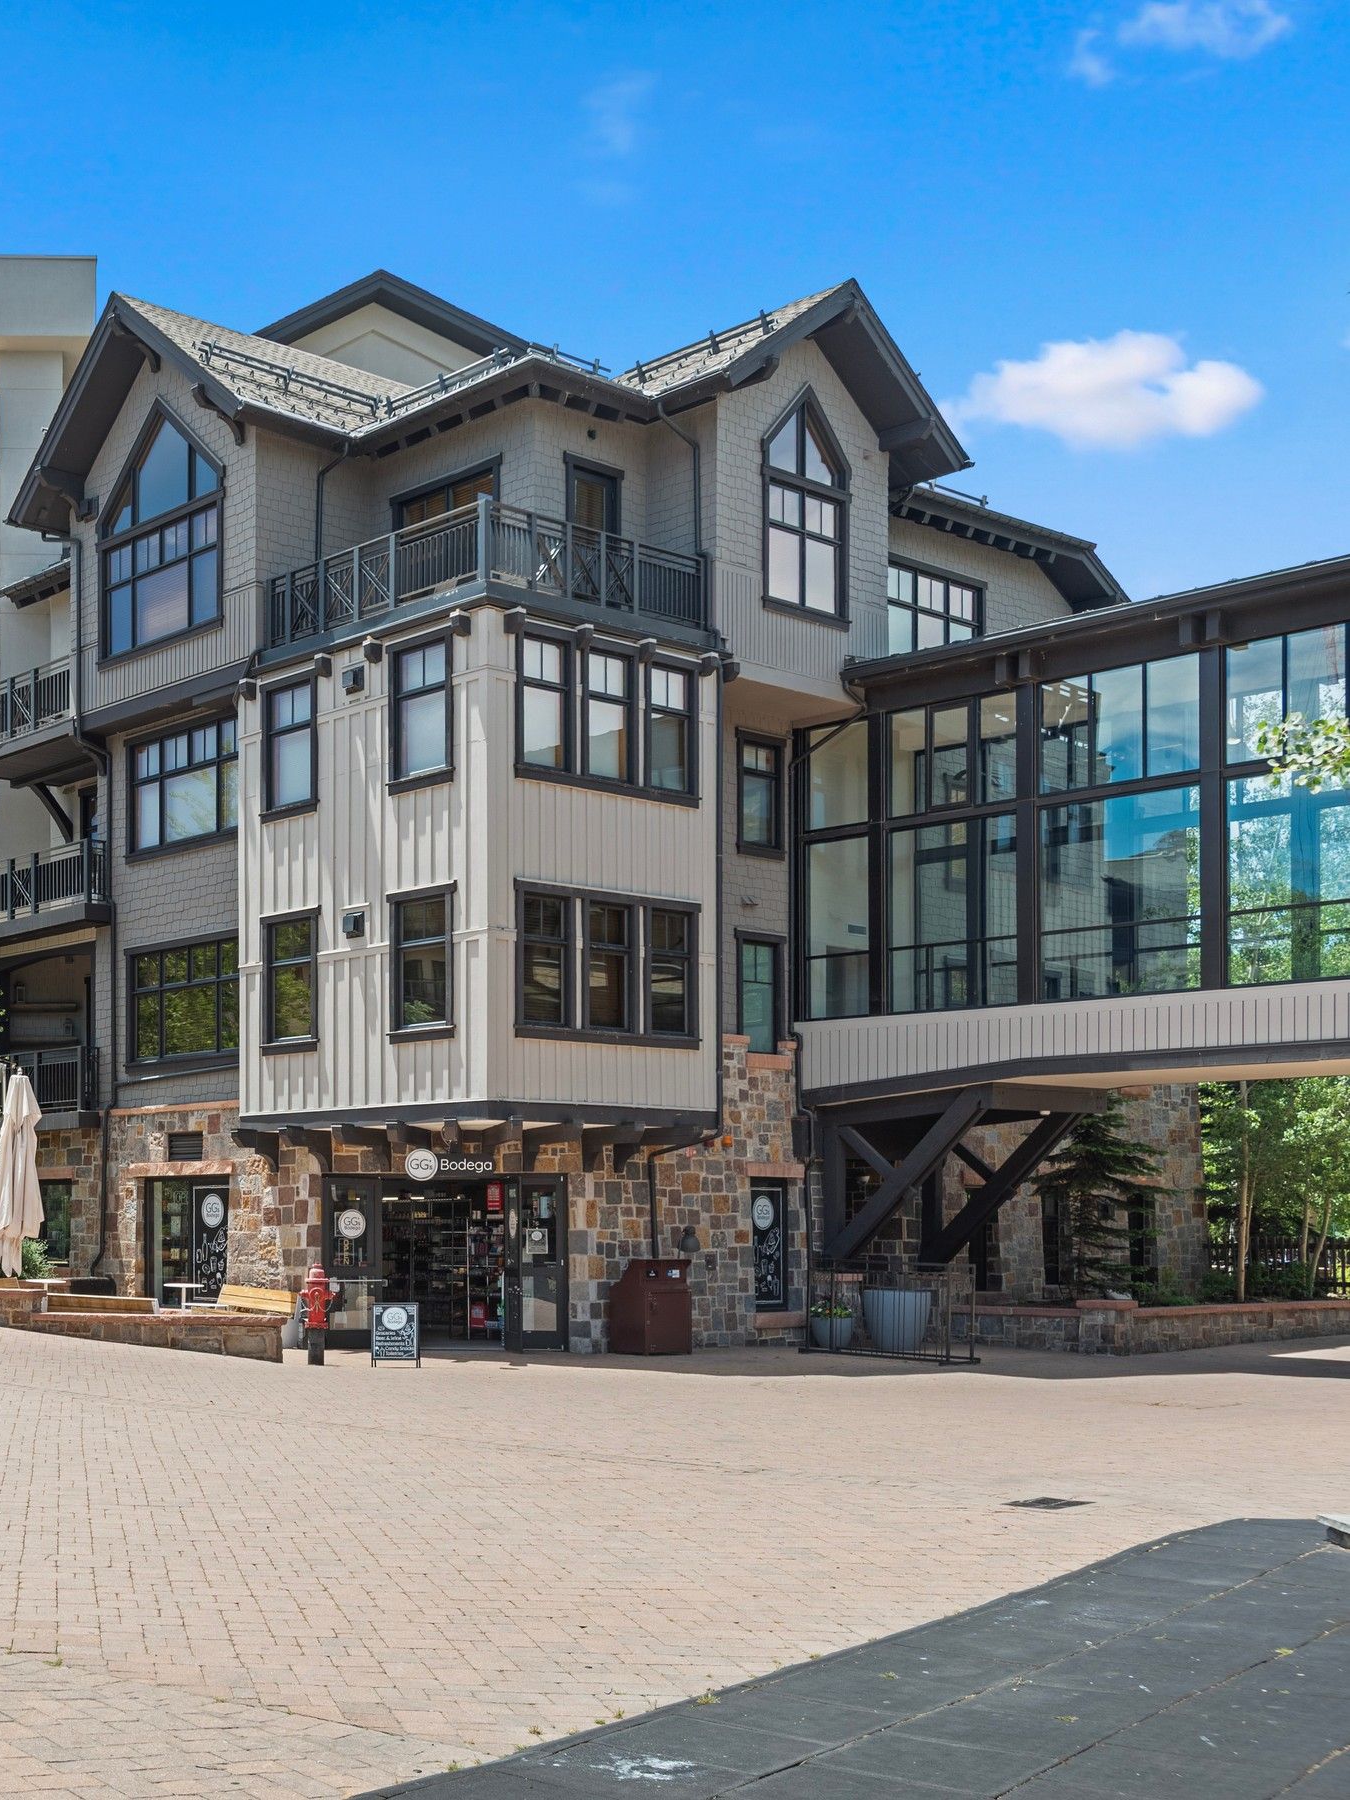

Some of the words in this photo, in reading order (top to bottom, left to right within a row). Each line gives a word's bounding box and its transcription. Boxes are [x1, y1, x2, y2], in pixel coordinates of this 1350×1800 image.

[410, 1158, 432, 1170] GG's
[440, 1158, 492, 1174] Bodega
[206, 1202, 220, 1213] GG's
[344, 1216, 361, 1226] GG's
